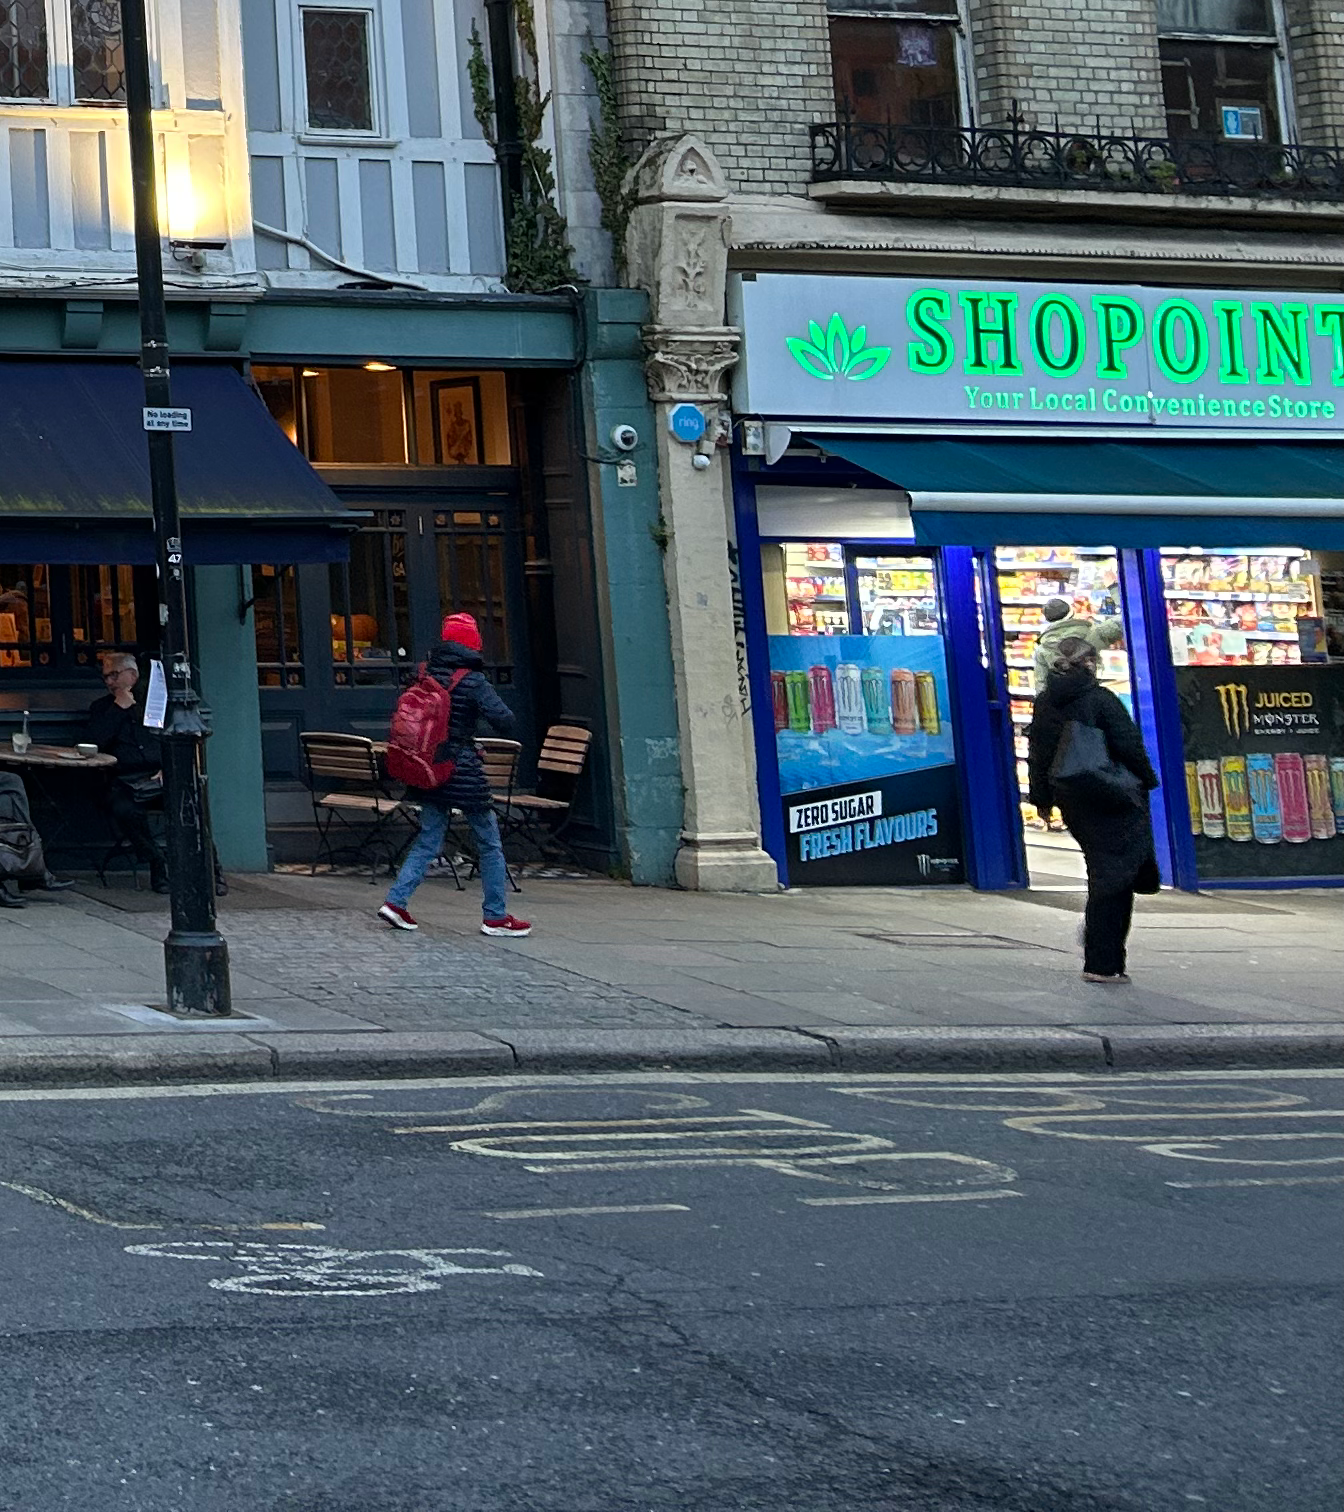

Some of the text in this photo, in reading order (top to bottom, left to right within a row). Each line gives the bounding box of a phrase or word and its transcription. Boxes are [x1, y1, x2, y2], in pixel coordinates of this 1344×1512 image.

[964, 385, 1336, 419] Your Local Convenience Store
[147, 410, 188, 420] No loading
[147, 419, 189, 428] at any time
[678, 416, 700, 431] ring
[168, 554, 182, 564] 47
[1255, 692, 1313, 708] JUICED
[1253, 712, 1320, 726] MONSTER
[796, 795, 875, 829] ZERO SUGAR
[799, 808, 938, 862] FRESH FLAVOURS
